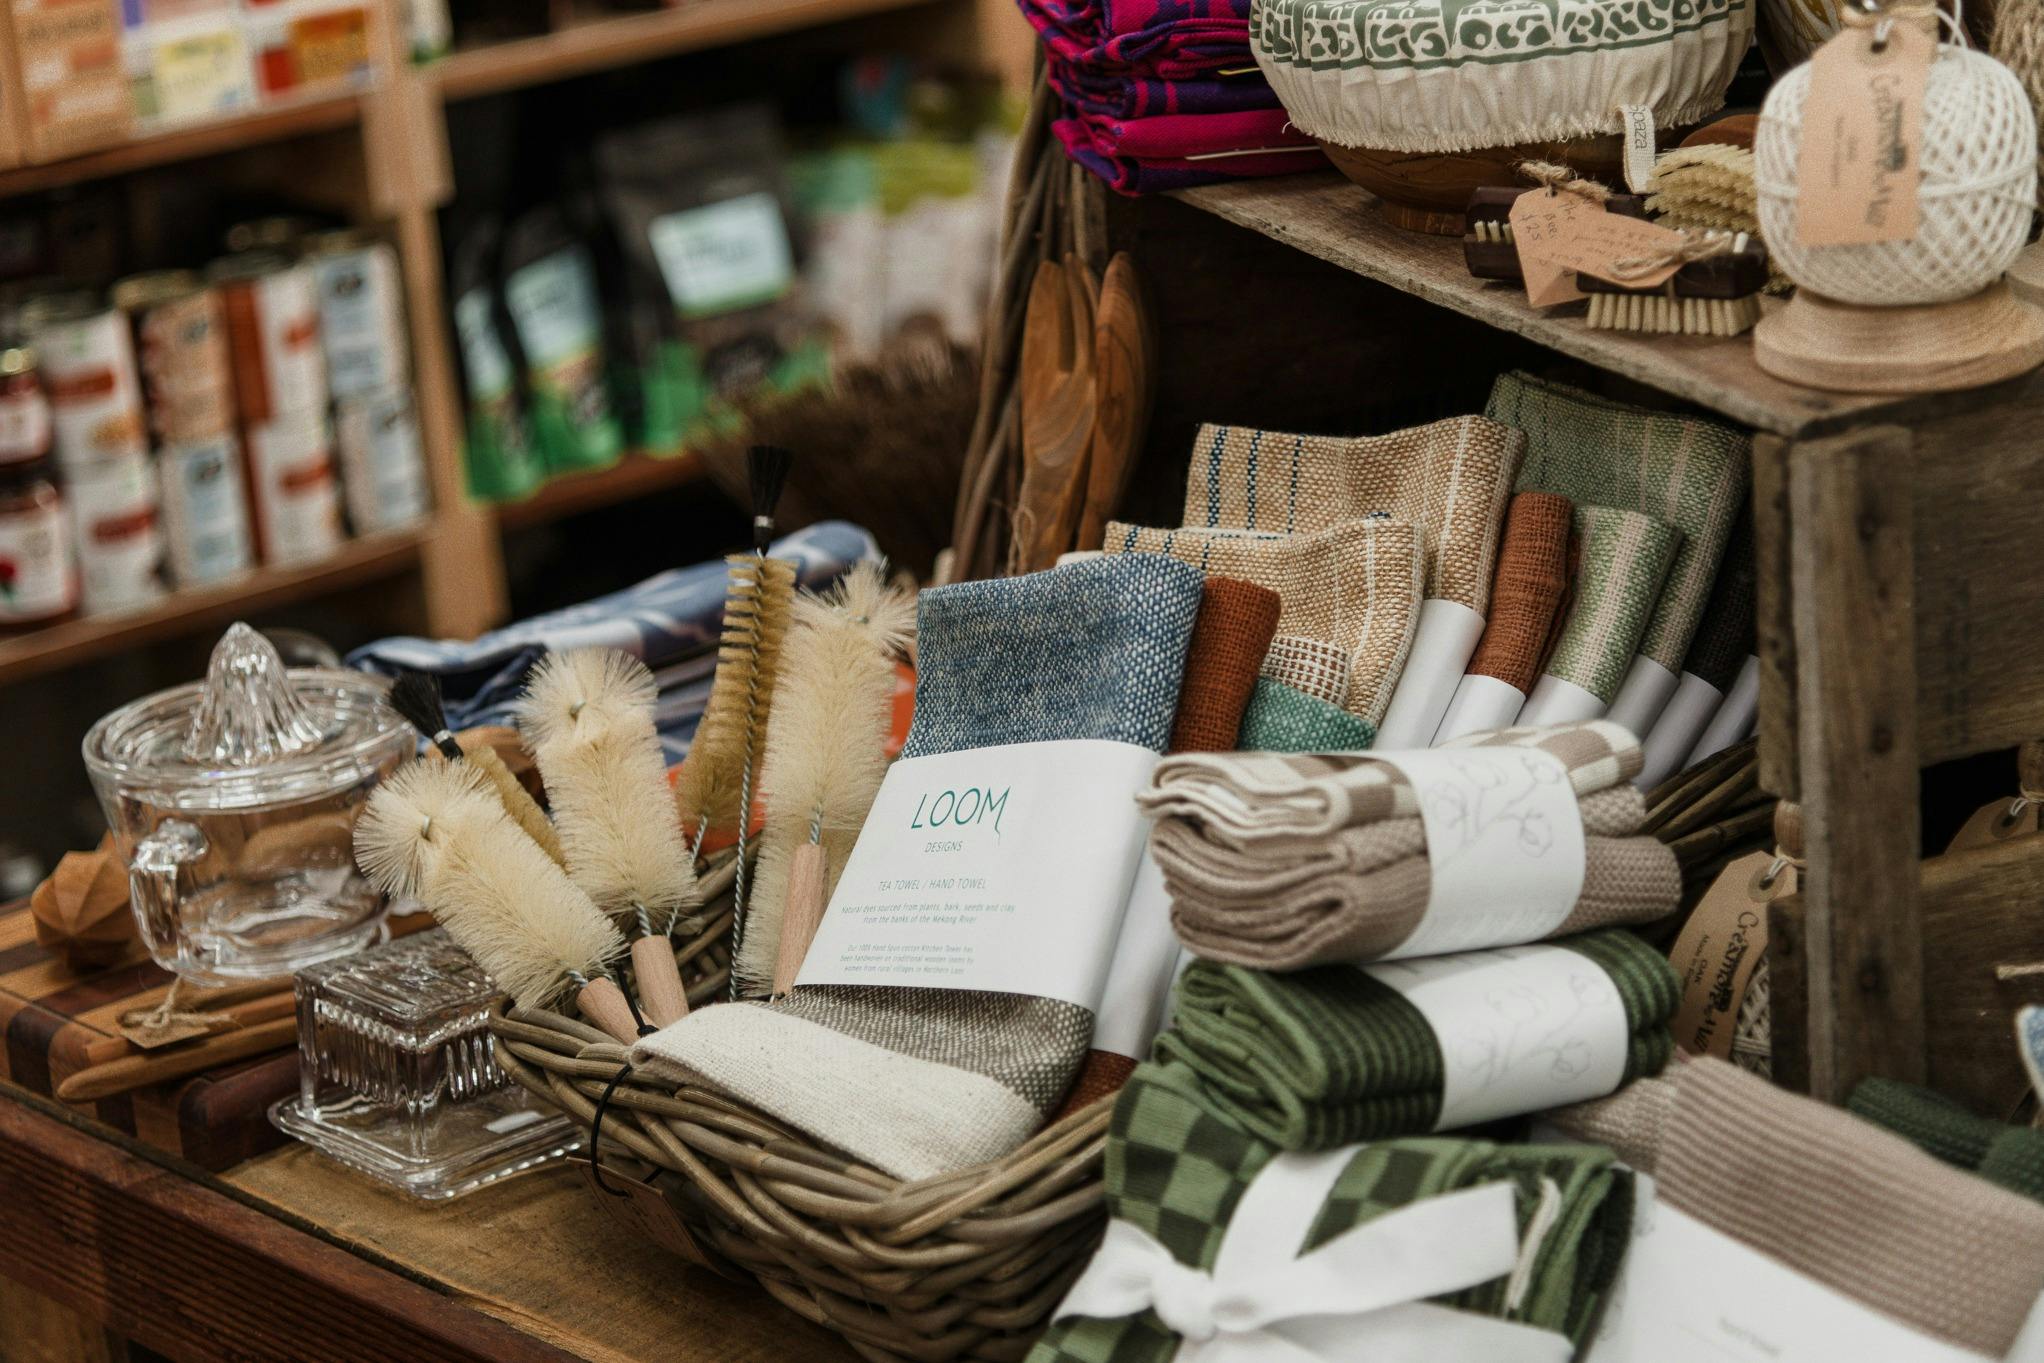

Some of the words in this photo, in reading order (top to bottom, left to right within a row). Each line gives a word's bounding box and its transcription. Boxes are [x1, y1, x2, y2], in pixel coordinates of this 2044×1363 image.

[911, 786, 1011, 839] LOOM
[924, 841, 963, 853] DESIGNS
[879, 881, 892, 891] TEA
[893, 880, 920, 890] TOWEL
[928, 879, 955, 889] HAND
[957, 878, 987, 889] TOWEL
[902, 903, 918, 912] from
